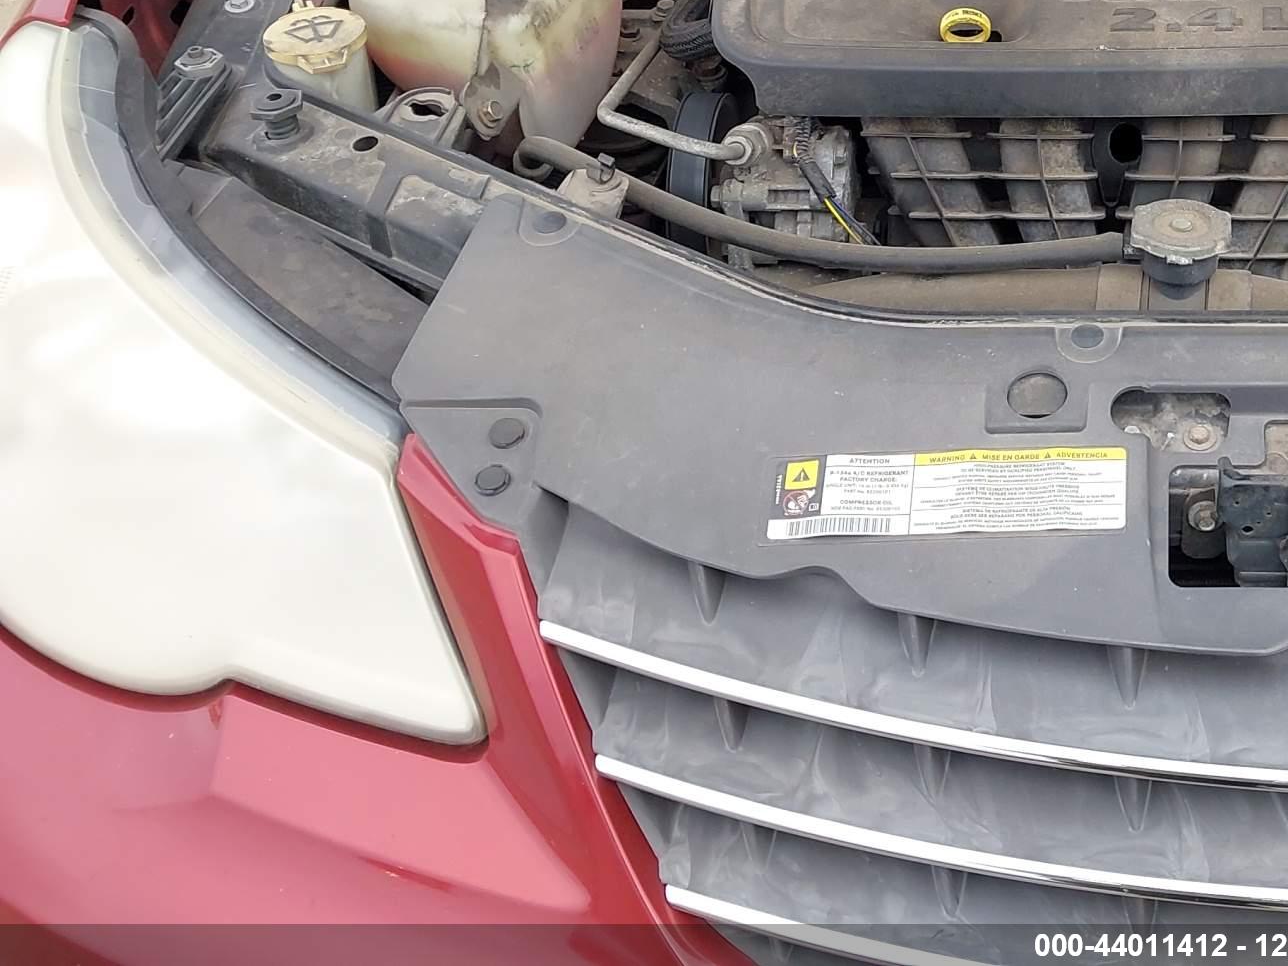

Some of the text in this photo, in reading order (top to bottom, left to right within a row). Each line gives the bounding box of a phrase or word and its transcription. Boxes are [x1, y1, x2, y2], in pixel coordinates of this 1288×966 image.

[849, 457, 890, 465] ATTENTION
[929, 454, 966, 463] WARNING
[982, 453, 1001, 461] MISE
[1056, 451, 1108, 459] ADVERTENCIA
